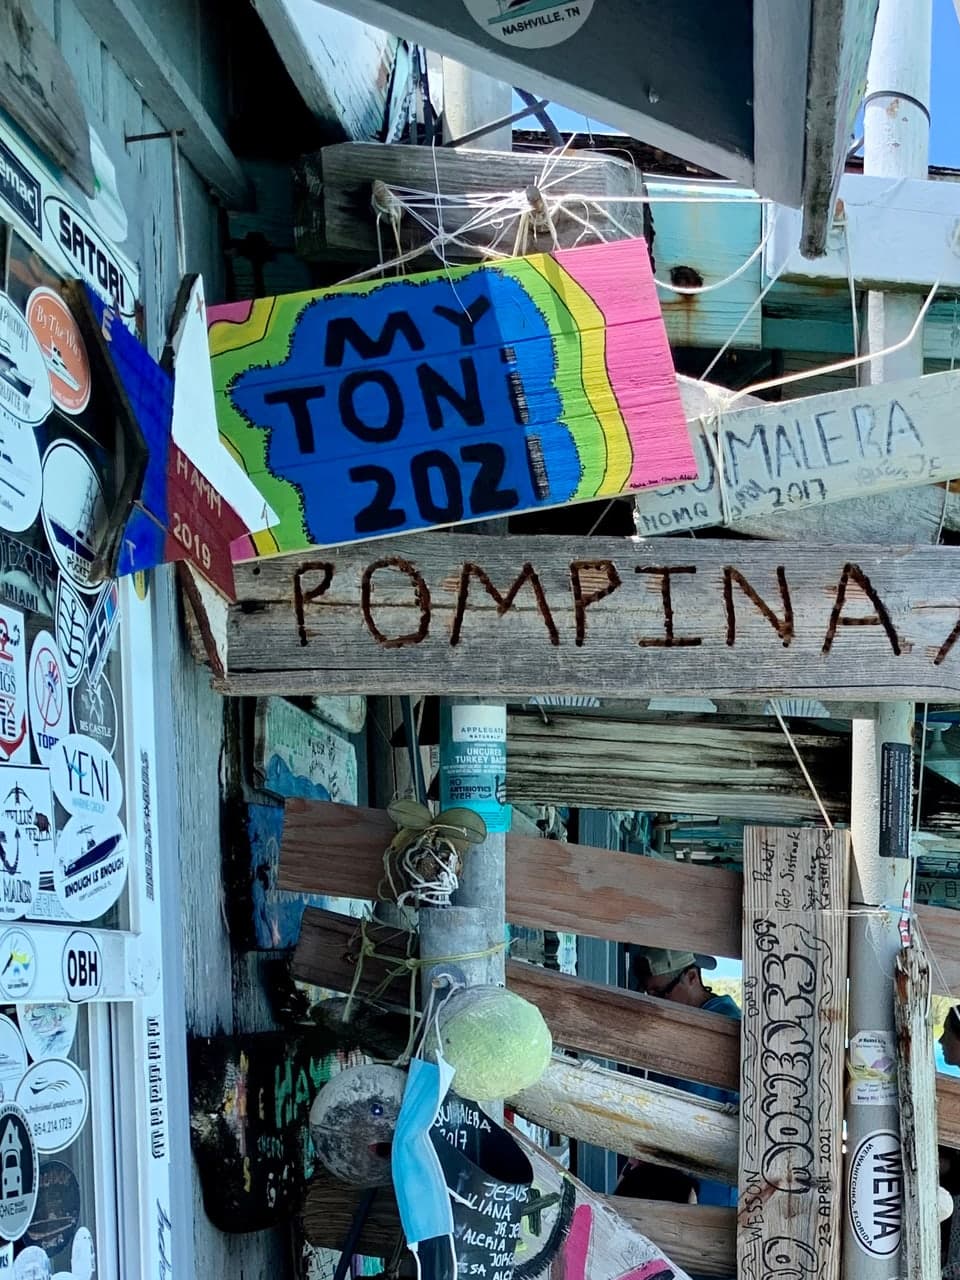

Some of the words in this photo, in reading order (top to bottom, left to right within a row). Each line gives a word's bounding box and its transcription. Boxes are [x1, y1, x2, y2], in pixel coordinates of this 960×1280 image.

[501, 12, 563, 37] NASHVILLE,
[565, 6, 581, 19] TN
[58, 206, 125, 308] SATORI
[49, 314, 65, 339] The
[324, 295, 492, 367] MY
[771, 477, 828, 508] 2017
[172, 515, 213, 571] 2019
[62, 744, 110, 802] YENI
[455, 755, 489, 764] TURKEY
[64, 875, 92, 899] ENOUGH
[100, 856, 125, 881] ENOUGH
[67, 949, 98, 987] OBH
[819, 1126, 833, 1164] 2021
[742, 1169, 765, 1244] WESSON
[817, 1168, 832, 1218] APRIL
[872, 1150, 901, 1241] WEWA
[818, 1224, 832, 1247] 23
[851, 1209, 874, 1247] FLORIDA
